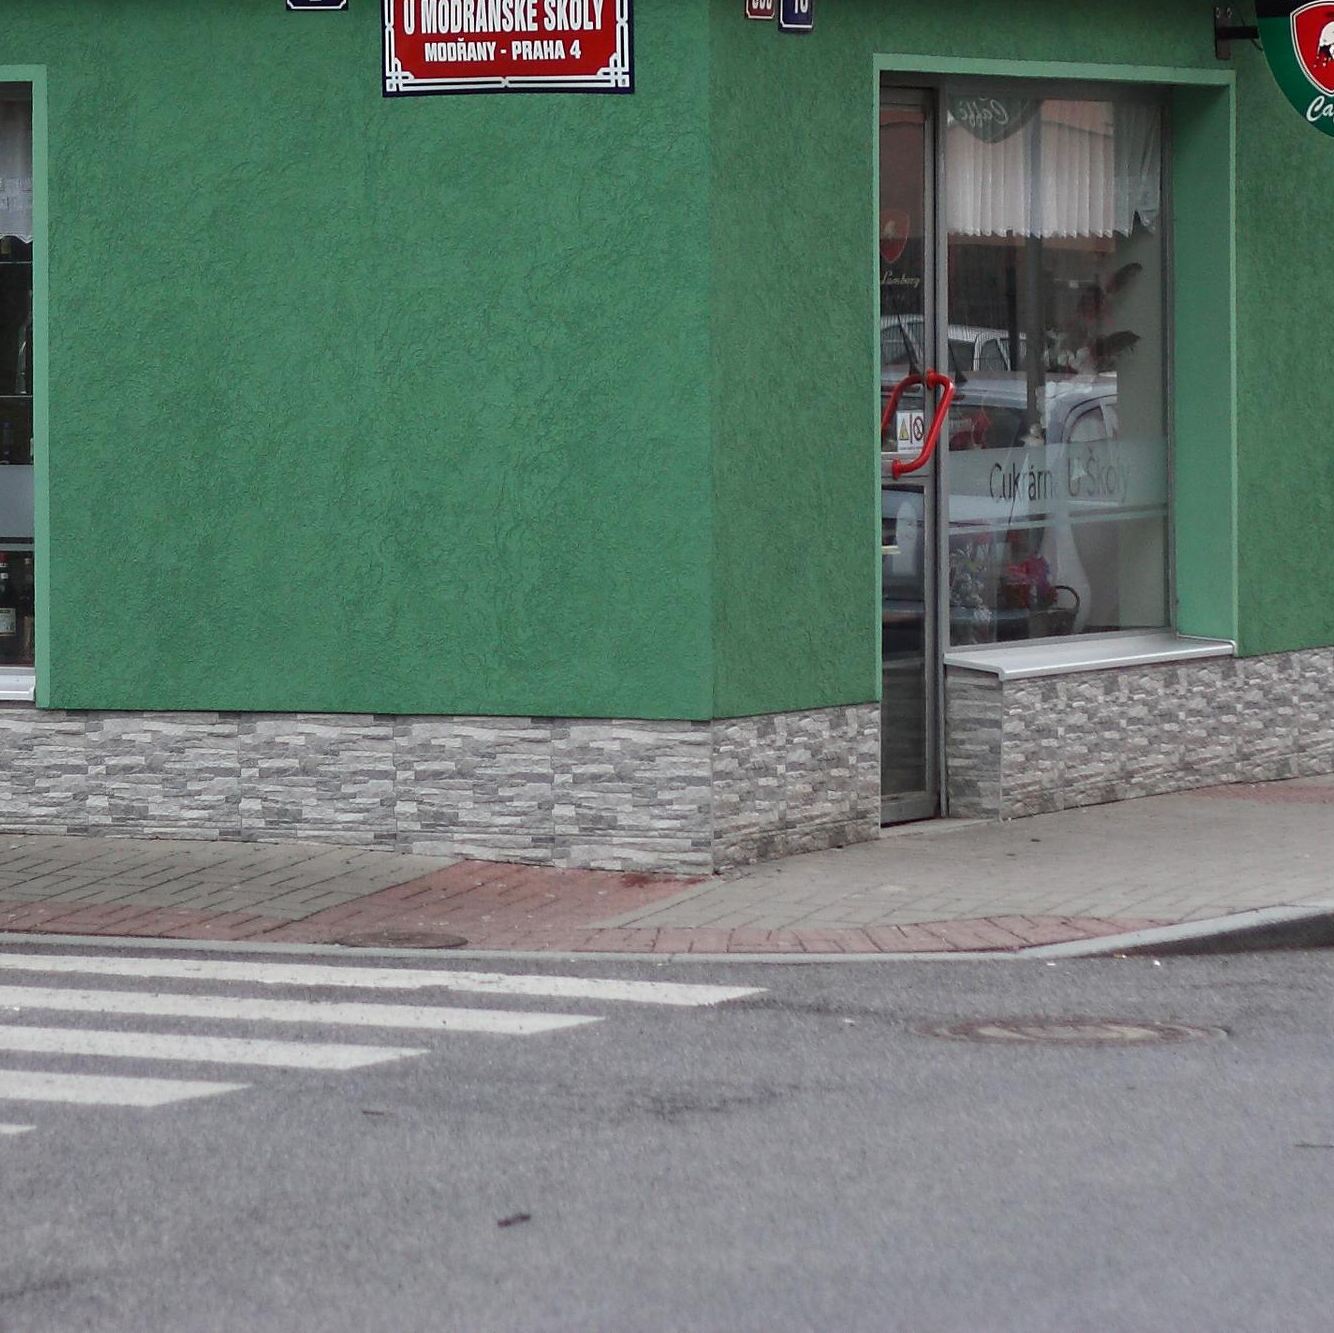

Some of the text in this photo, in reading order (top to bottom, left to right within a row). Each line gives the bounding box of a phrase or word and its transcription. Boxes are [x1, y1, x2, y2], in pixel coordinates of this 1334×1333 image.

[424, 38, 497, 62] MODŘANY
[511, 40, 566, 60] PRAHA
[569, 39, 582, 59] 4
[1068, 457, 1081, 497] U
